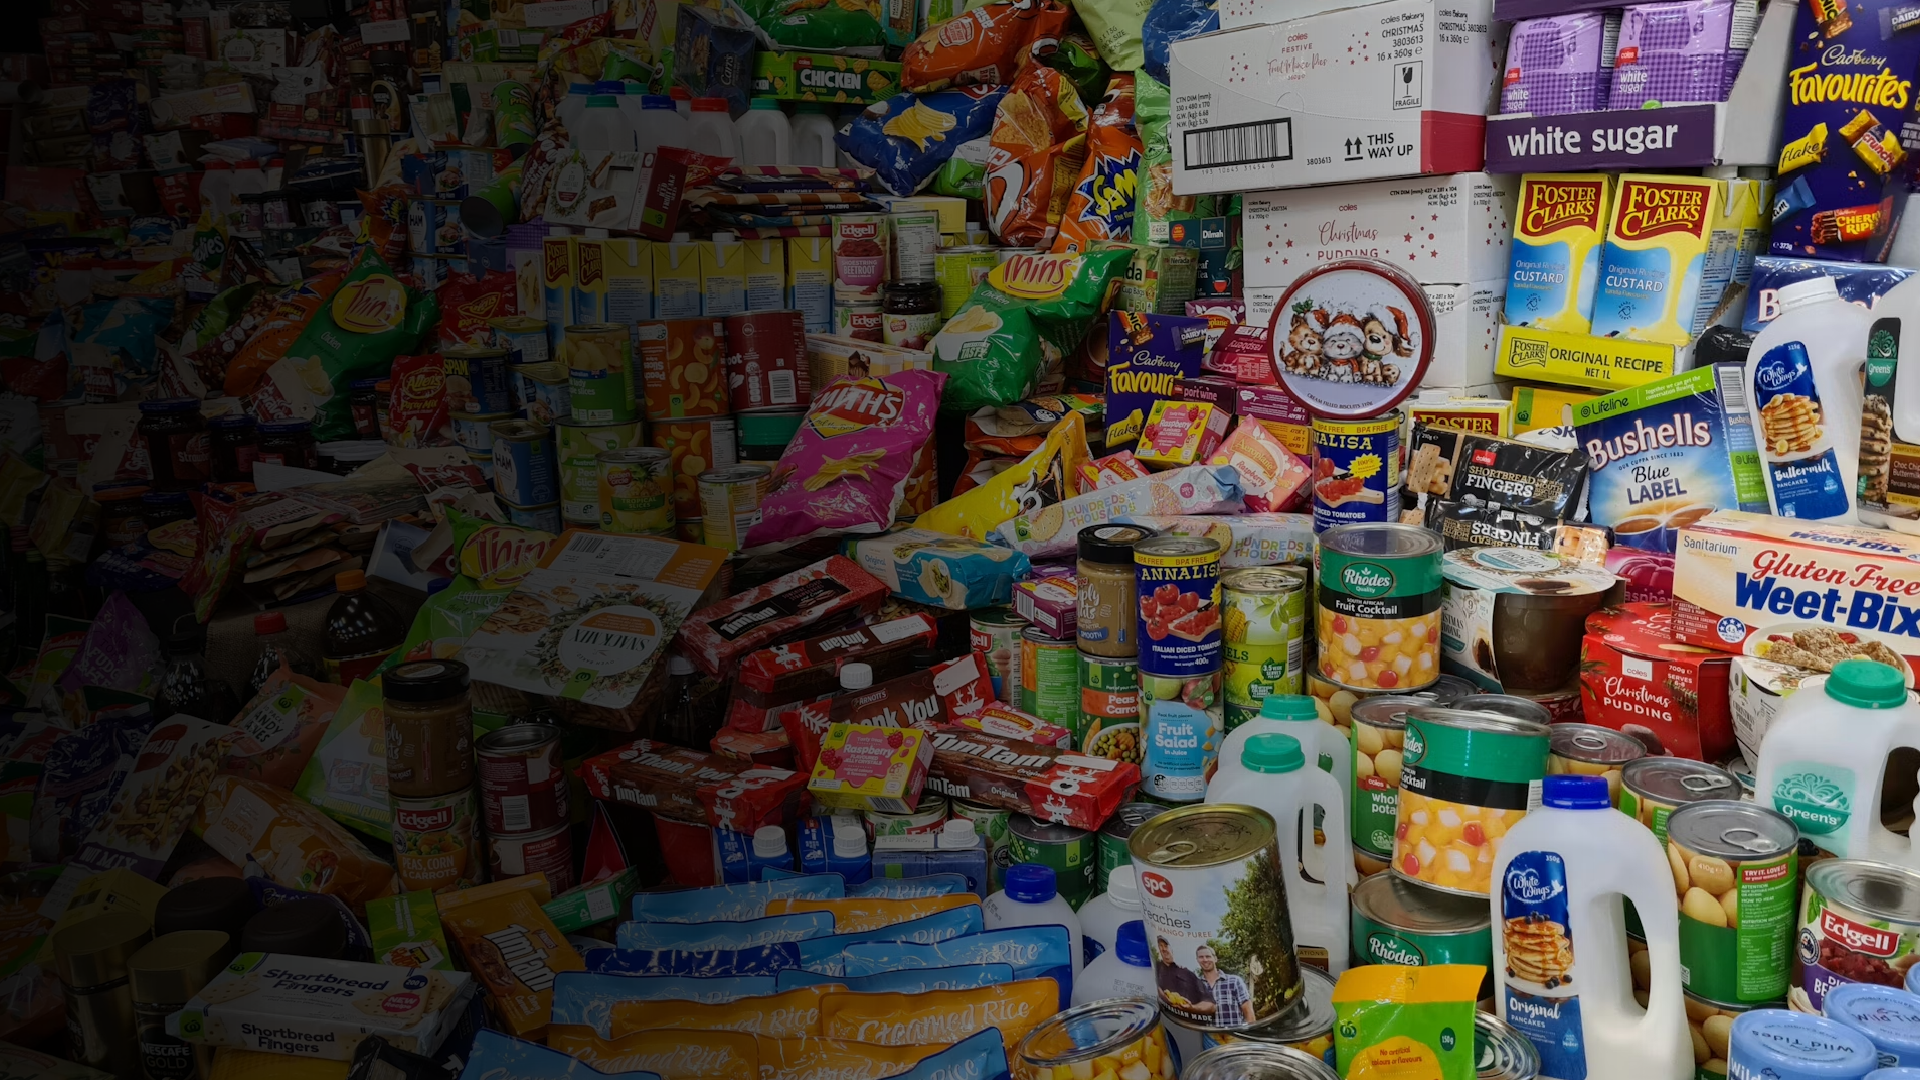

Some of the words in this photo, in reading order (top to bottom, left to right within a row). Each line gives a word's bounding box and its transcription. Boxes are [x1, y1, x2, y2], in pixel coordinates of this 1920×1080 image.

[1381, 15, 1400, 24] coles
[1401, 12, 1425, 23] Bakery
[1288, 32, 1308, 42] coles
[1382, 23, 1423, 39] CHRISTMAS
[1282, 43, 1313, 54] FESTIVE
[1392, 35, 1423, 46] 3803613
[1822, 44, 1887, 69] Cadbury
[800, 68, 862, 90] CHICKEN
[1620, 70, 1648, 82] white
[1619, 83, 1644, 93] sugar
[1789, 62, 1911, 110] Favourites
[1395, 98, 1420, 107] FRAGILE
[1507, 90, 1529, 100] white
[1506, 100, 1526, 110] sugar
[1367, 133, 1394, 145] THIS
[1507, 127, 1581, 156] white
[1592, 124, 1679, 155] sugar
[1368, 147, 1395, 159] WAY
[1397, 144, 1413, 156] UP
[1781, 142, 1820, 169] flake
[1306, 156, 1332, 166] 3803613
[1530, 183, 1596, 212] FOSTER
[1625, 184, 1702, 214] FOSTER
[1339, 203, 1357, 212] coles
[841, 224, 875, 237] Edgell
[1203, 230, 1223, 239] Dilmah
[1318, 219, 1379, 246] Christmas
[1318, 248, 1379, 260] PUDDING
[1779, 242, 1792, 250] 373g
[1004, 253, 1072, 284] Thins
[1171, 257, 1190, 265] Nerada
[843, 265, 876, 276] BEETROOT
[1514, 270, 1564, 284] CUSTARD
[1122, 286, 1132, 294] Cup
[1132, 288, 1145, 296] Bags
[1606, 276, 1663, 292] CUSTARD
[980, 288, 1010, 306] Chicken
[1513, 339, 1545, 351] FOSTER
[1133, 350, 1181, 369] Cadbury
[1550, 347, 1610, 367] ORIGINAL
[1614, 357, 1663, 373] RECIPE
[1585, 367, 1599, 377] NET
[1762, 366, 1784, 383] White
[1772, 369, 1796, 388] Wings
[422, 400, 438, 410] Mix
[810, 388, 901, 420] SMITH'S
[1591, 395, 1629, 415] Lifeline
[1159, 420, 1191, 430] Raspberry
[1420, 414, 1492, 433] FOSTER
[1586, 412, 1712, 472] Bushells
[495, 452, 512, 472] HAM
[1235, 437, 1274, 471] Aeroplane
[608, 472, 630, 482] golden
[1469, 466, 1535, 485] SHORTBREAD
[1631, 464, 1670, 483] Blue
[1774, 459, 1834, 481] Buttermilk
[610, 478, 630, 486] circle
[1465, 474, 1534, 497] FINGERS
[1627, 477, 1687, 505] LABEL
[622, 496, 657, 505] TROPICAL
[1067, 495, 1126, 519] HUNDREDS
[1332, 510, 1366, 519] TOMATOES
[1471, 523, 1540, 545] FINGERS
[1683, 536, 1738, 555] Sanitarium
[864, 555, 886, 566] Original
[1191, 556, 1207, 564] FREE
[1141, 566, 1221, 581] ANNALISA
[1344, 569, 1391, 587] Rhodes
[1753, 550, 1849, 585] Gluten
[1849, 563, 1920, 597] Free
[1336, 600, 1355, 612] Fruit
[1357, 604, 1397, 615] Cocktail
[1736, 571, 1920, 638] Weet-Bix
[1152, 645, 1175, 653] ITALIAN
[1176, 646, 1196, 654] DICED
[1626, 669, 1648, 678] coles
[1668, 664, 1686, 674] 700g
[1667, 673, 1693, 684] SERVES
[1108, 695, 1135, 705] Peas
[1603, 676, 1672, 708] Christmas
[901, 694, 939, 724] You
[1603, 697, 1673, 722] PUDDING
[1158, 722, 1193, 737] Fruit
[1155, 735, 1198, 749] Salad
[843, 744, 894, 758] Raspberry
[630, 753, 695, 773] Thank
[690, 766, 735, 781] You
[1368, 779, 1384, 788] coles
[671, 794, 693, 804] Original
[991, 787, 1019, 800] Original
[400, 810, 447, 829] Edgell
[1782, 804, 1839, 826] Green's
[79, 846, 100, 861] NUT
[99, 850, 138, 870] MIX
[402, 854, 425, 872] PEAS,
[427, 854, 455, 870] CORN
[1546, 854, 1560, 864] 350g
[402, 869, 408, 878] &
[409, 867, 458, 880] CARROTS
[1144, 875, 1168, 894] spc
[1513, 876, 1539, 892] White
[1522, 882, 1550, 900] Wings
[1142, 903, 1192, 930] Peaches
[1157, 927, 1185, 938] MANGO
[1187, 930, 1212, 938] PUREE
[1824, 914, 1890, 951] Edgell
[1369, 937, 1420, 966] Rhodes
[262, 968, 389, 992] Shortbread
[272, 979, 356, 998] Fingers
[386, 1002, 412, 1010] Recipe
[388, 995, 417, 1005] NEW
[982, 1000, 1034, 1027] Rice
[1509, 998, 1561, 1019] Original
[1190, 1013, 1213, 1022] MADE
[1511, 1014, 1546, 1029] PANCAKES
[241, 1022, 335, 1043] Shortbread
[258, 1036, 320, 1054] Fingers
[146, 1056, 188, 1069] GOLD
